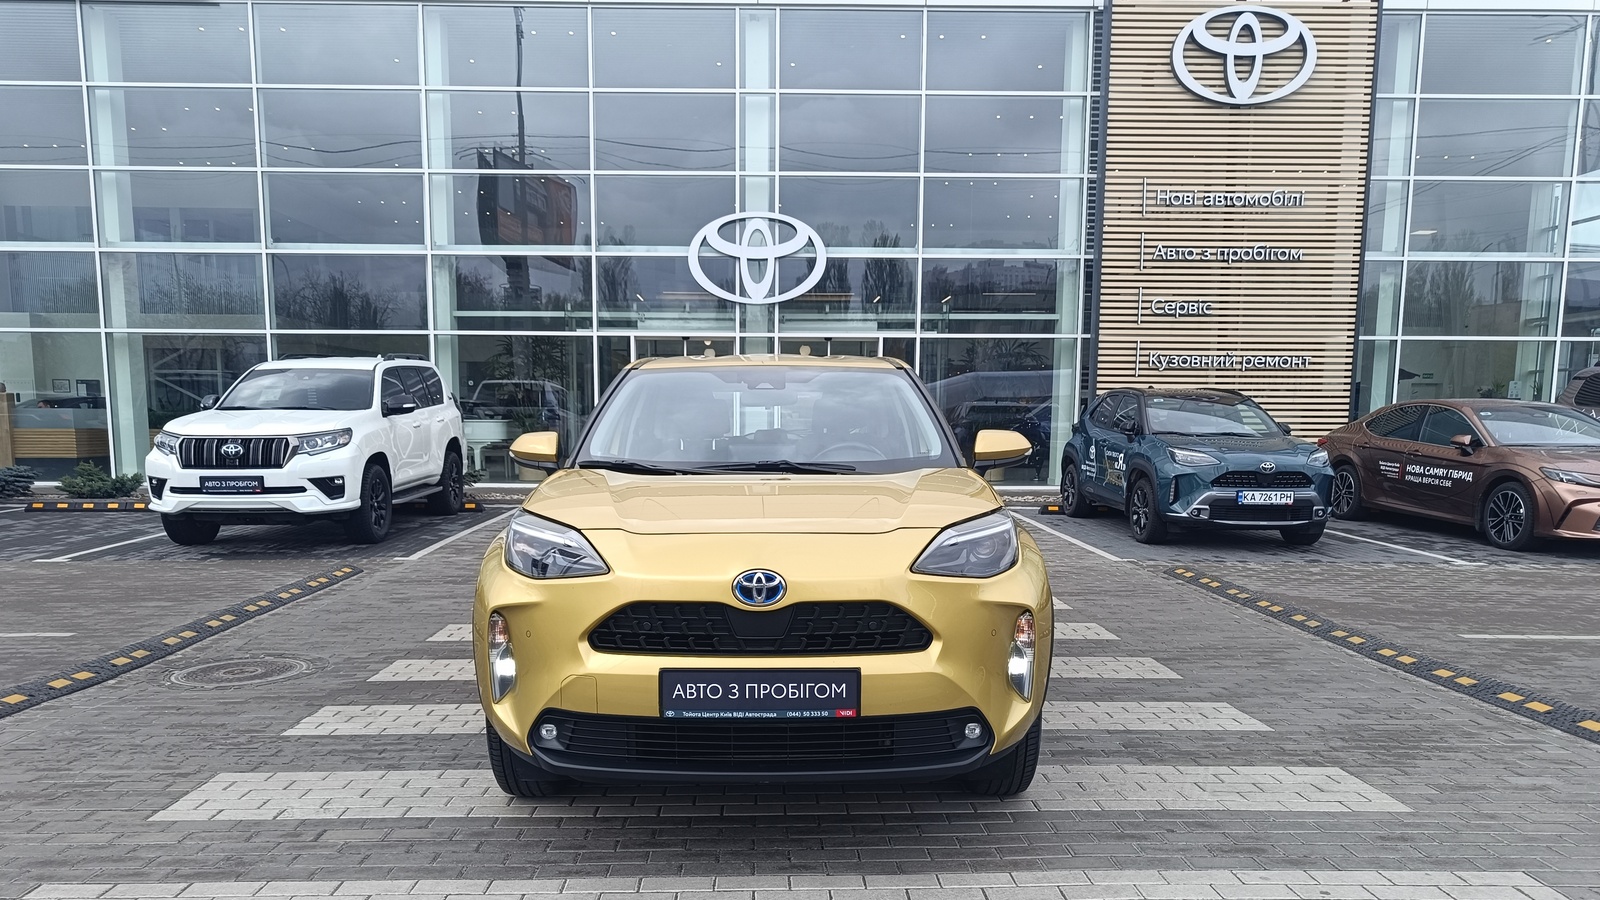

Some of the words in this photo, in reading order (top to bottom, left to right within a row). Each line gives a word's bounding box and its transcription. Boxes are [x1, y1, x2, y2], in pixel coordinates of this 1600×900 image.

[1156, 189, 1198, 206] Нові
[1203, 189, 1306, 207] автомобілі
[1153, 244, 1197, 260] Авто
[1201, 246, 1211, 260] з
[1217, 243, 1304, 264] пробігом
[1151, 299, 1213, 318] Сервіс
[1149, 351, 1237, 371] Кузовний
[1242, 355, 1312, 372] ремонт
[1406, 464, 1424, 474] НОВА
[1448, 469, 1473, 482] ГІБРИД
[1259, 492, 1278, 502] 7261
[672, 683, 723, 699] АВТО
[728, 683, 739, 699] З
[745, 683, 847, 699] ПРОБІГОМ
[786, 710, 802, 718] (044)
